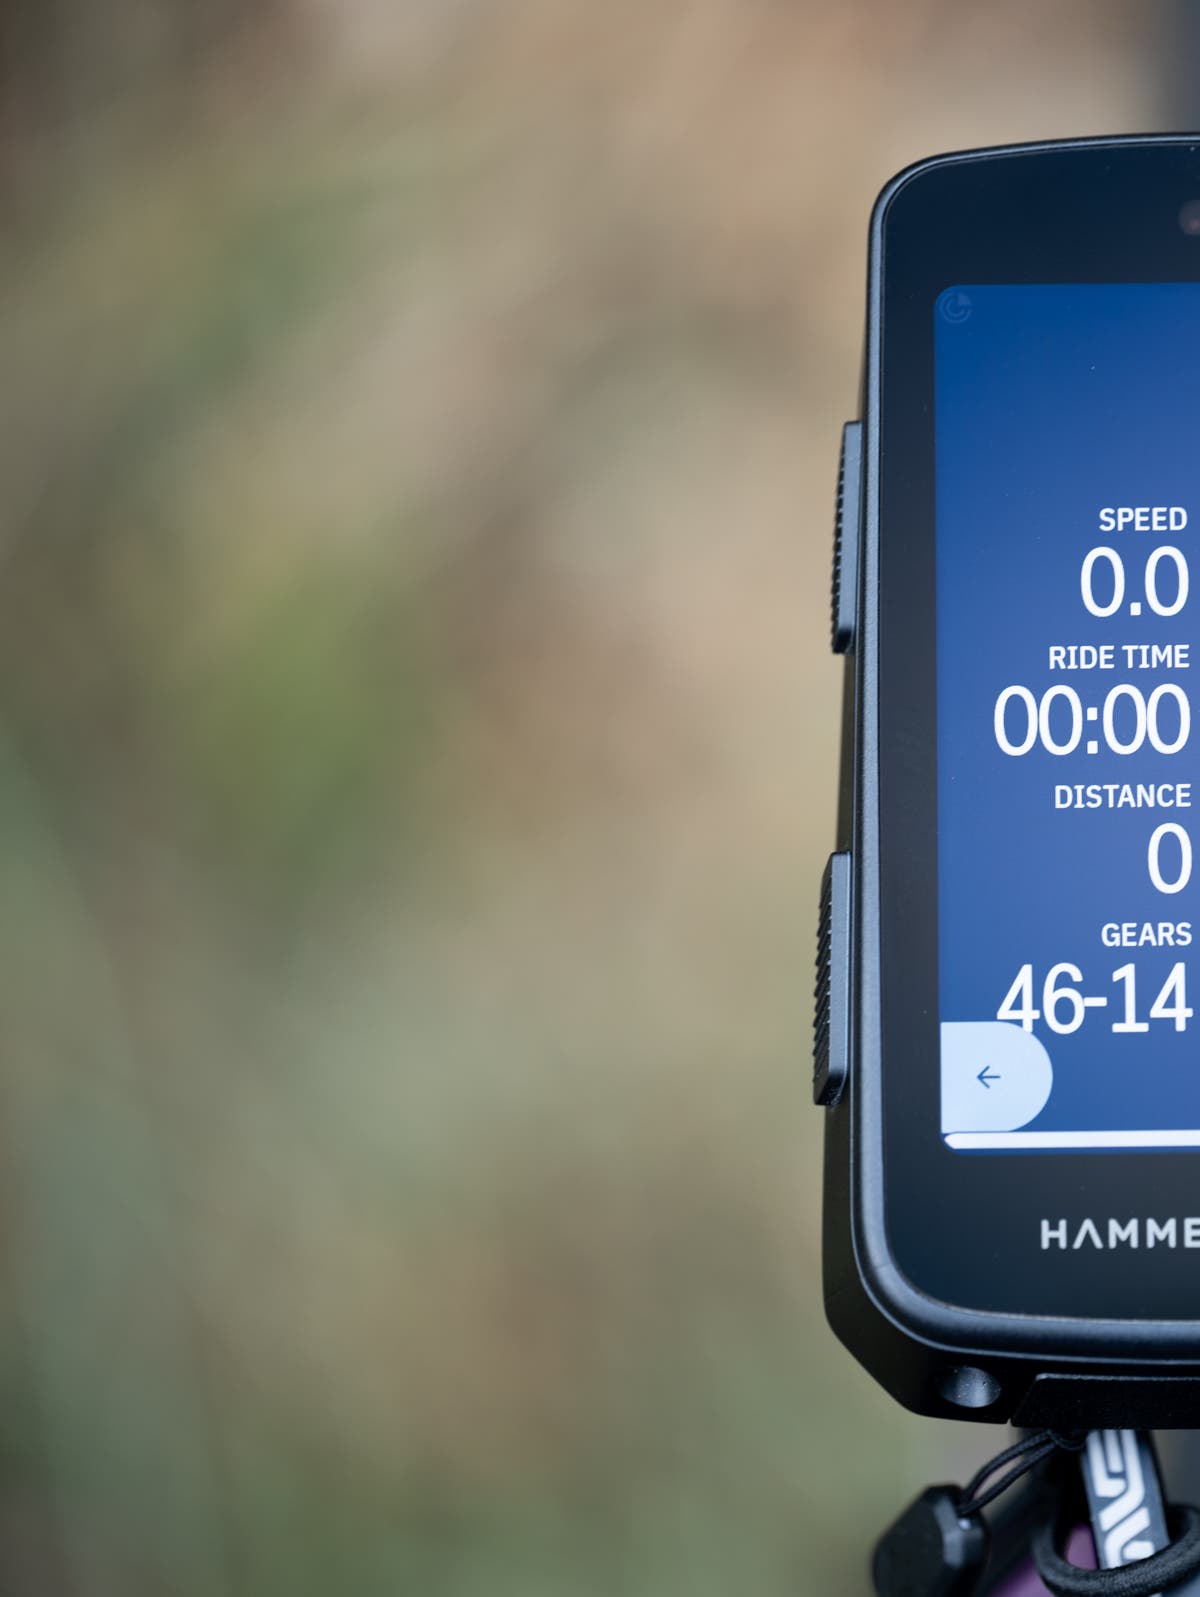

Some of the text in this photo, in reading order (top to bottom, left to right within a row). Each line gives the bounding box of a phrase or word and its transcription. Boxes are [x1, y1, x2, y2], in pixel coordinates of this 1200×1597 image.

[1099, 506, 1188, 532] SPEED
[1080, 545, 1189, 618] 0.0
[1049, 644, 1190, 670] RIDE TIME
[993, 683, 1191, 757] 00:00
[1054, 783, 1192, 809] DISTANCE
[1147, 822, 1193, 895] 0
[1101, 921, 1193, 947] GEARS
[996, 962, 1194, 1035] 46-14
